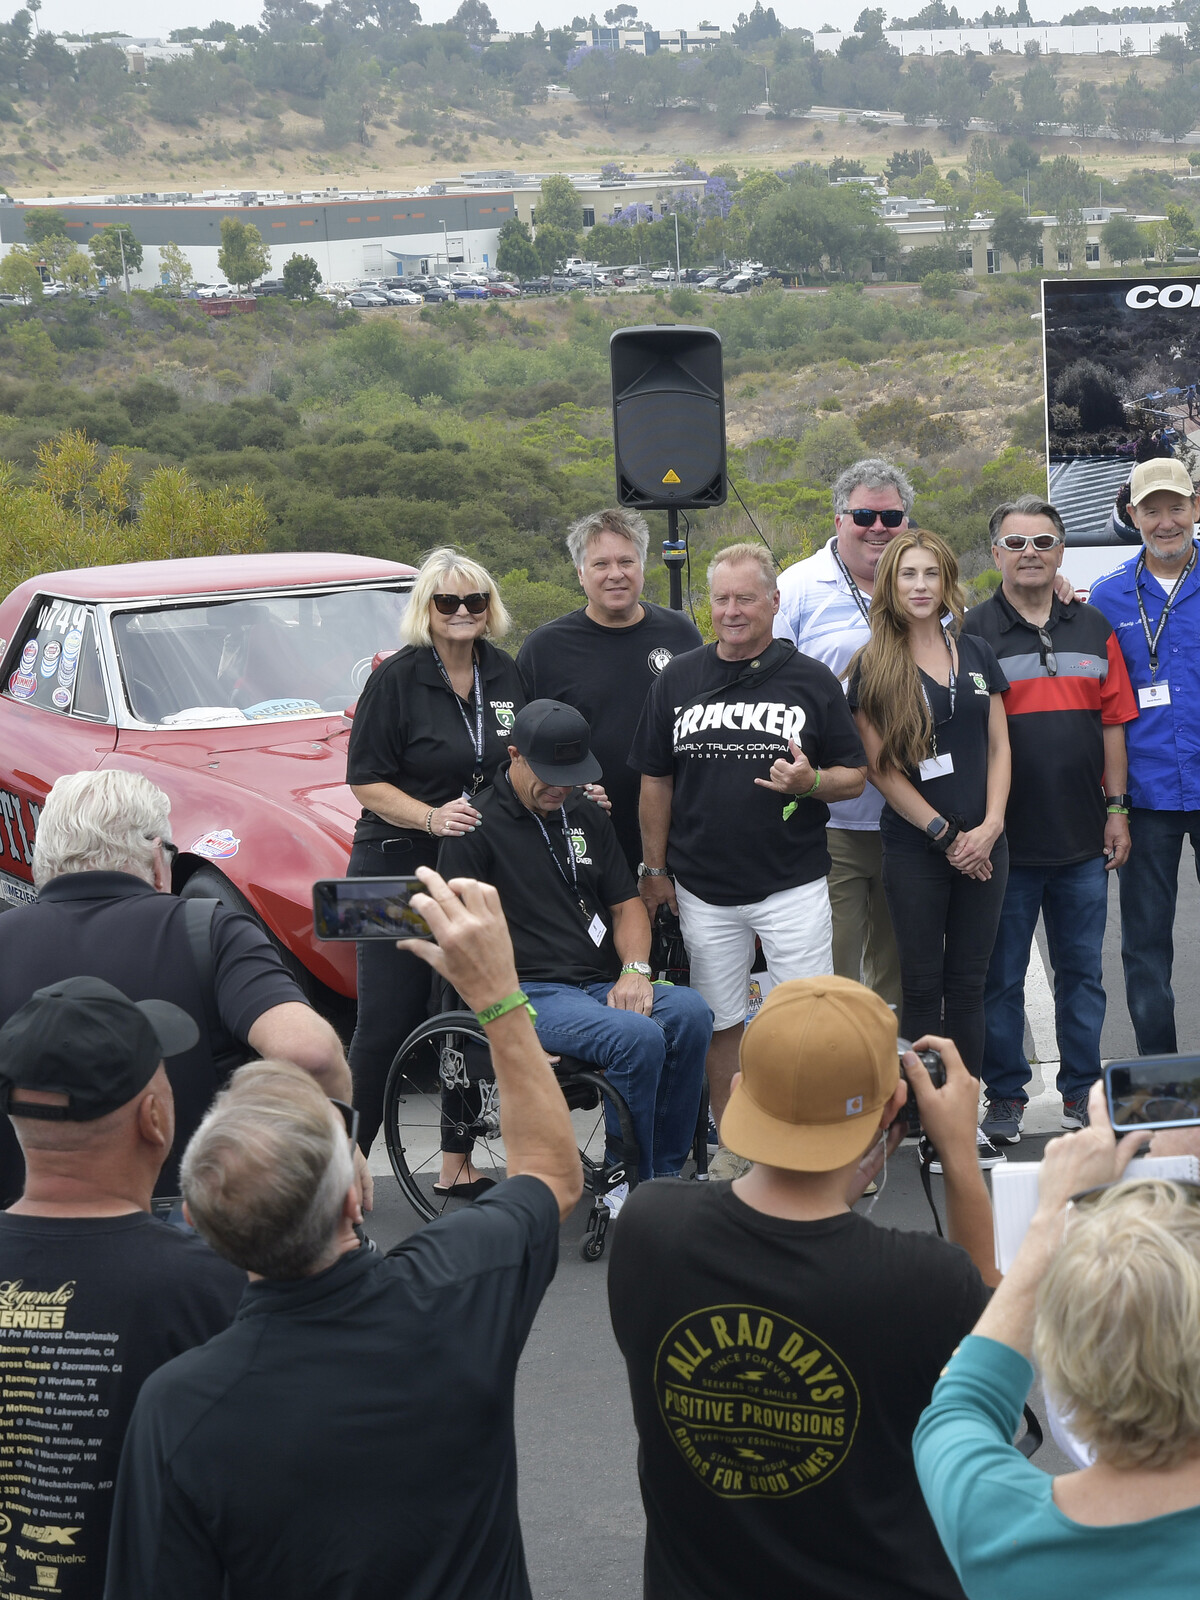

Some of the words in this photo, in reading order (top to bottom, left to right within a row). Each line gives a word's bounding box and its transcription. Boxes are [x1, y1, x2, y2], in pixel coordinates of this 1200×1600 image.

[489, 701, 514, 709] ROAD
[501, 714, 512, 726] 2
[706, 743, 745, 751] TRUCK
[573, 841, 583, 853] 2
[480, 1003, 503, 1021] VIP
[0, 1279, 76, 1311] Legends
[0, 1311, 65, 1329] EROES
[8, 1329, 21, 1338] Pro
[23, 1330, 63, 1340] Motocross
[65, 1331, 119, 1343] Championship
[41, 1346, 55, 1355] San
[57, 1347, 102, 1357] Bernardino,
[104, 1348, 115, 1357] CA
[666, 1328, 713, 1381] ALL
[710, 1313, 774, 1350] RAD
[778, 1331, 845, 1402] DAYS
[24, 1360, 51, 1371] Classic
[61, 1362, 111, 1373] Sacramento,
[112, 1364, 122, 1373] CA
[710, 1352, 741, 1374] SINCE
[745, 1352, 791, 1385] FOREVER
[5, 1374, 37, 1386] Raceway
[47, 1377, 85, 1387] Wortham,
[87, 1378, 97, 1387] TX
[3, 1389, 36, 1400] Raceway
[44, 1391, 57, 1400] Mt.
[58, 1392, 87, 1402] Morris,
[89, 1393, 99, 1402] PA
[702, 1378, 744, 1391] SEEKERS
[749, 1384, 760, 1394] OF
[763, 1387, 798, 1400] SMILES
[6, 1404, 44, 1415] Motocross
[53, 1407, 95, 1418] Lakewood,
[97, 1409, 110, 1418] CO
[665, 1388, 734, 1423] POSITIVE
[742, 1402, 845, 1437] PROVISIONS
[25, 1418, 60, 1433] Buchanan,
[62, 1423, 74, 1431] MI
[7, 1432, 43, 1444] Motocross
[88, 1438, 102, 1447] MN
[694, 1432, 744, 1445] EVERYDAY
[748, 1435, 801, 1453] ESSENTIALS
[17, 1446, 33, 1455] Park
[84, 1452, 97, 1461] WA
[675, 1427, 710, 1477] GOODS
[712, 1467, 743, 1490] FOR
[750, 1472, 789, 1492] GOOD
[789, 1446, 834, 1482] TIMES
[62, 1466, 74, 1475] NY
[762, 1458, 789, 1474] ISSUE
[4, 1486, 19, 1495] 338
[64, 1495, 78, 1504] MA
[40, 1508, 73, 1520] Delmont,
[75, 1512, 85, 1520] PA
